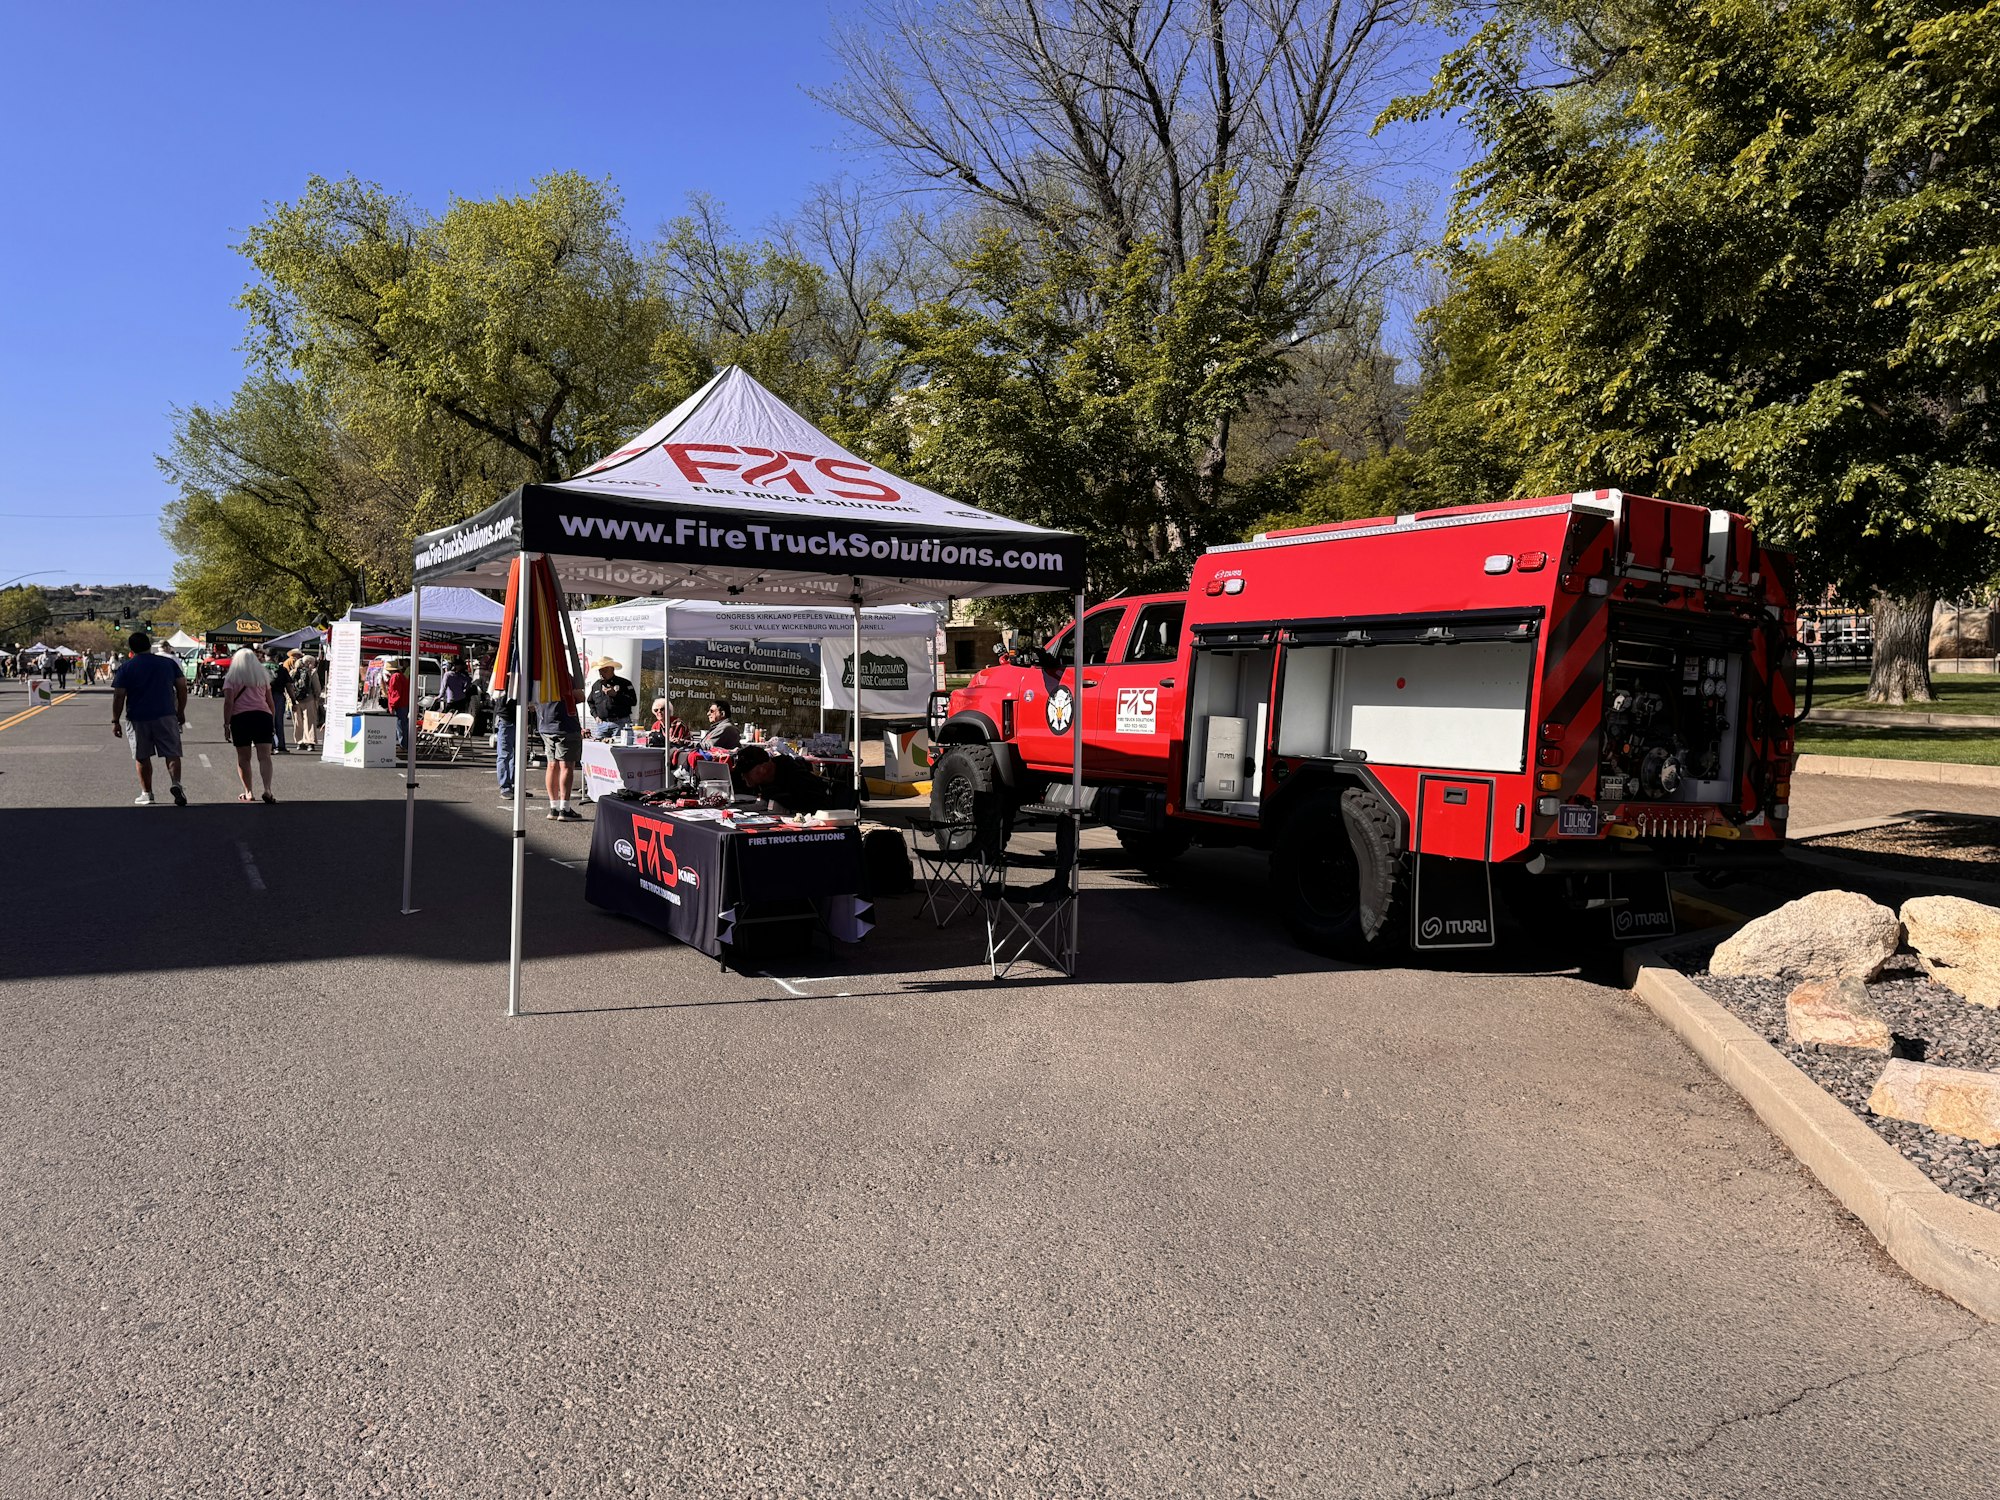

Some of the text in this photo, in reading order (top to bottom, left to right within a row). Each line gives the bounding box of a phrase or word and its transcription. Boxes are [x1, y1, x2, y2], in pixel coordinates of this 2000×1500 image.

[691, 485, 921, 514] FIRE TRUCK SOLUTIONS
[415, 515, 515, 570] www.FireTruckSolutions.com
[558, 515, 1063, 571] www.FireTruckSolutions.com
[425, 642, 458, 650] Extension
[707, 641, 801, 660] Weaver Mountains
[695, 655, 811, 676] Firewise Communities
[668, 675, 708, 688] Congress
[725, 679, 760, 690] Kirkland
[778, 684, 807, 696] Peeples
[657, 687, 821, 707] Rger Ranch Skull Valley Wicken
[730, 704, 787, 716] hoit Yarnell
[608, 768, 617, 779] USA
[749, 832, 845, 846] FIRE TRUCK SOLUTIONS
[677, 868, 697, 886] KME
[1445, 919, 1487, 934] ITURRI
[1635, 911, 1669, 926] ITURRI
